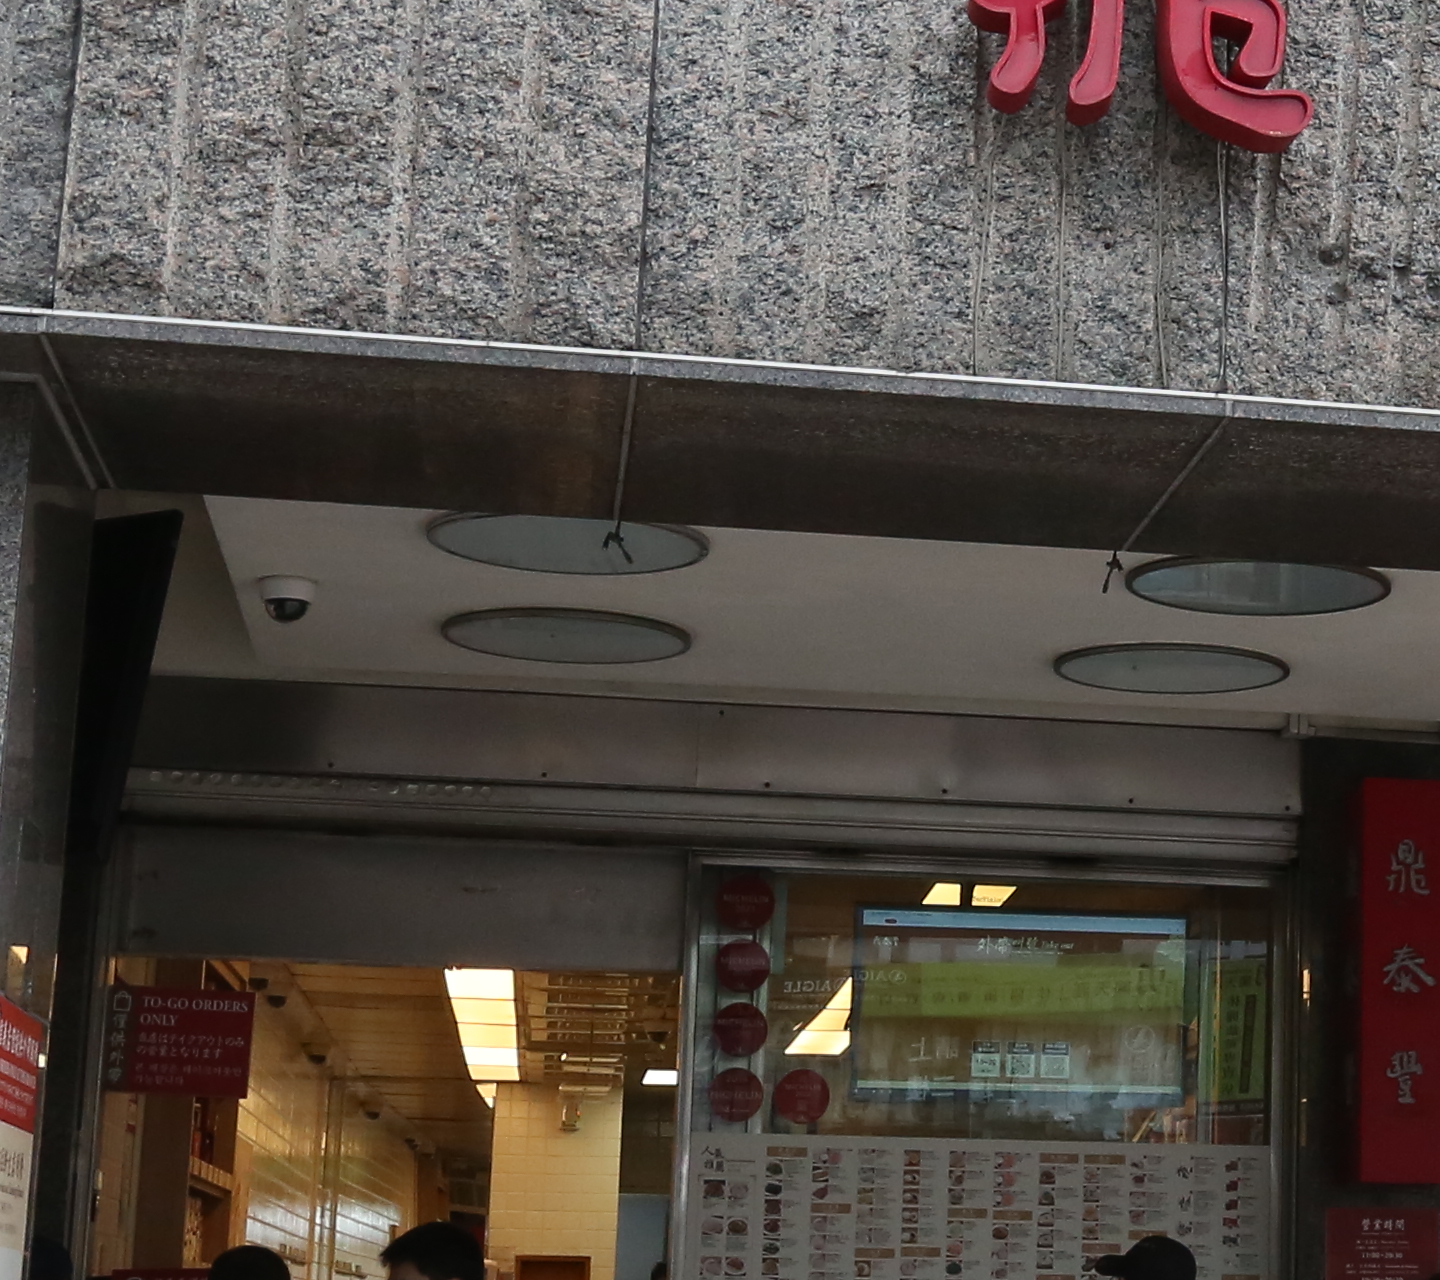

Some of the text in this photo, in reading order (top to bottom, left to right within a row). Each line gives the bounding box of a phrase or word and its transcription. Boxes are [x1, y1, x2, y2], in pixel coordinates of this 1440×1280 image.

[1383, 839, 1437, 1104] 鼎泰豐
[142, 996, 248, 1013] TO-GO ORDERS
[140, 1014, 178, 1026] ONLY
